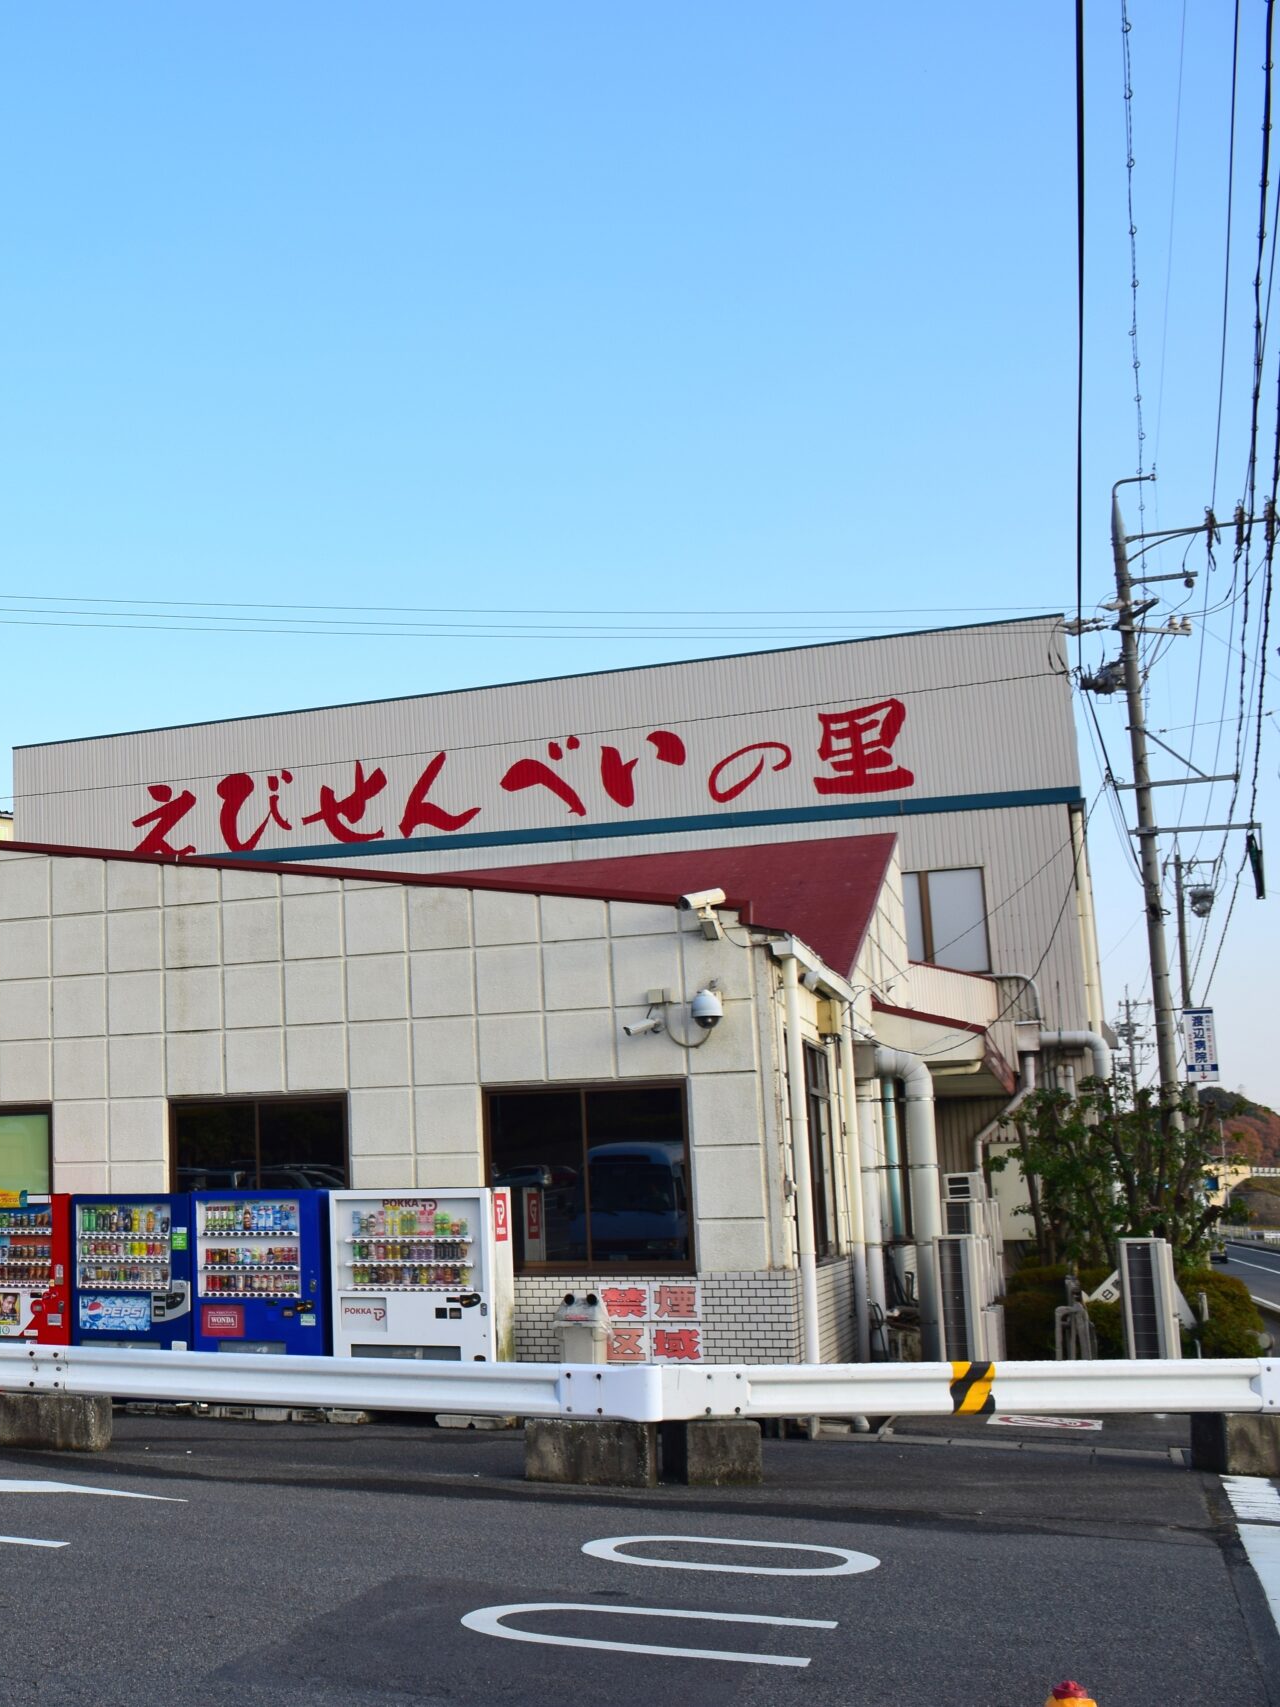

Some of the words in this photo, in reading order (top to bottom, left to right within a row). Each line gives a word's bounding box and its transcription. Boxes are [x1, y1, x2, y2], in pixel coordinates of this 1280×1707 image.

[132, 698, 915, 856] えびせんべいの里
[1192, 1016, 1208, 1063] 渡辺病院
[382, 1199, 419, 1207] POKKA
[102, 1307, 146, 1319] PEPSI
[344, 1307, 372, 1315] POKKA
[601, 1286, 698, 1318] 禁煙
[607, 1328, 701, 1360] 区域
